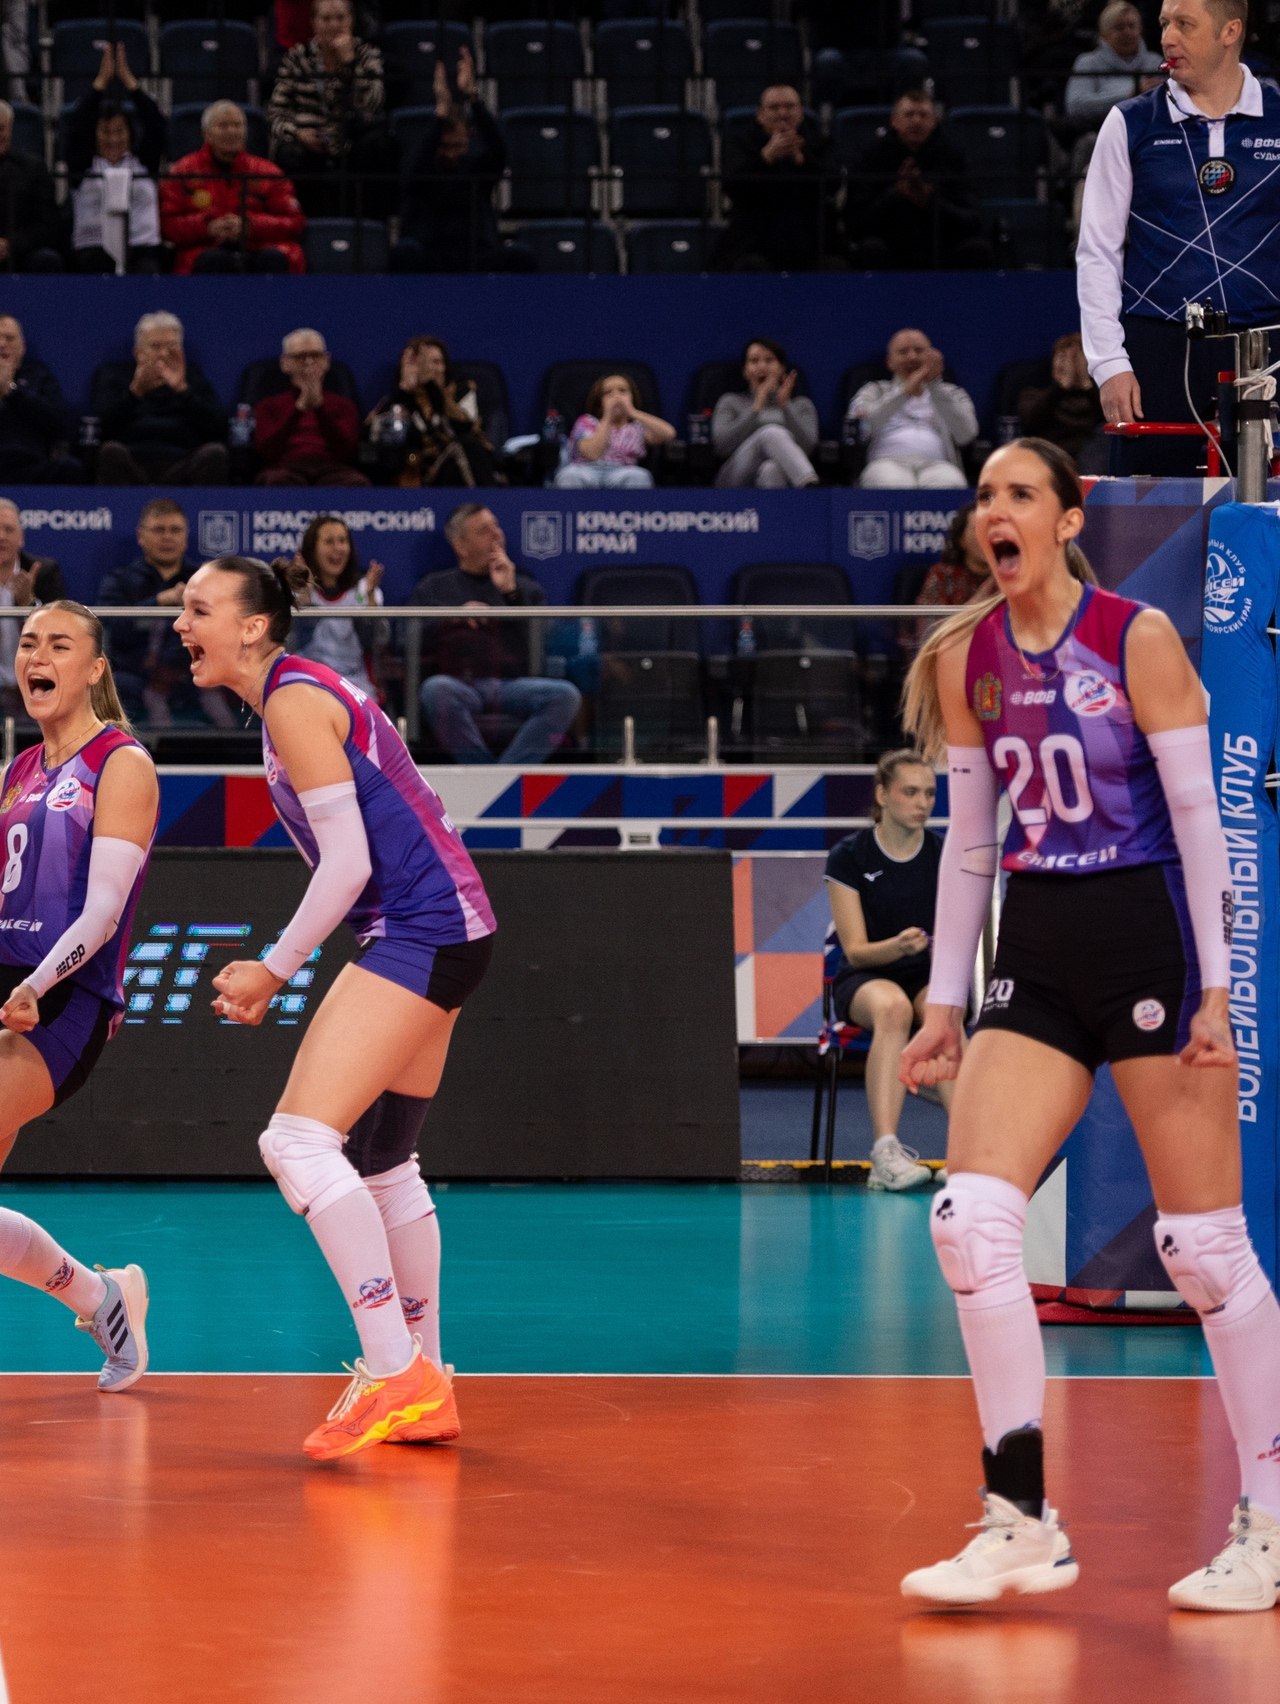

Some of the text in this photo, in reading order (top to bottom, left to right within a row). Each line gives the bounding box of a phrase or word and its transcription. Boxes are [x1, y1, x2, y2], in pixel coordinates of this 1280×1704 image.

[576, 508, 759, 532] КРАСНОЯРСКИЙ
[576, 532, 637, 553] КРАЙ
[903, 533, 947, 553] КРА
[993, 733, 1094, 823] 20
[1220, 733, 1258, 820] КЛУБ
[1, 823, 28, 894] 8
[64, 943, 86, 970] cep
[984, 979, 1014, 1005] 20
